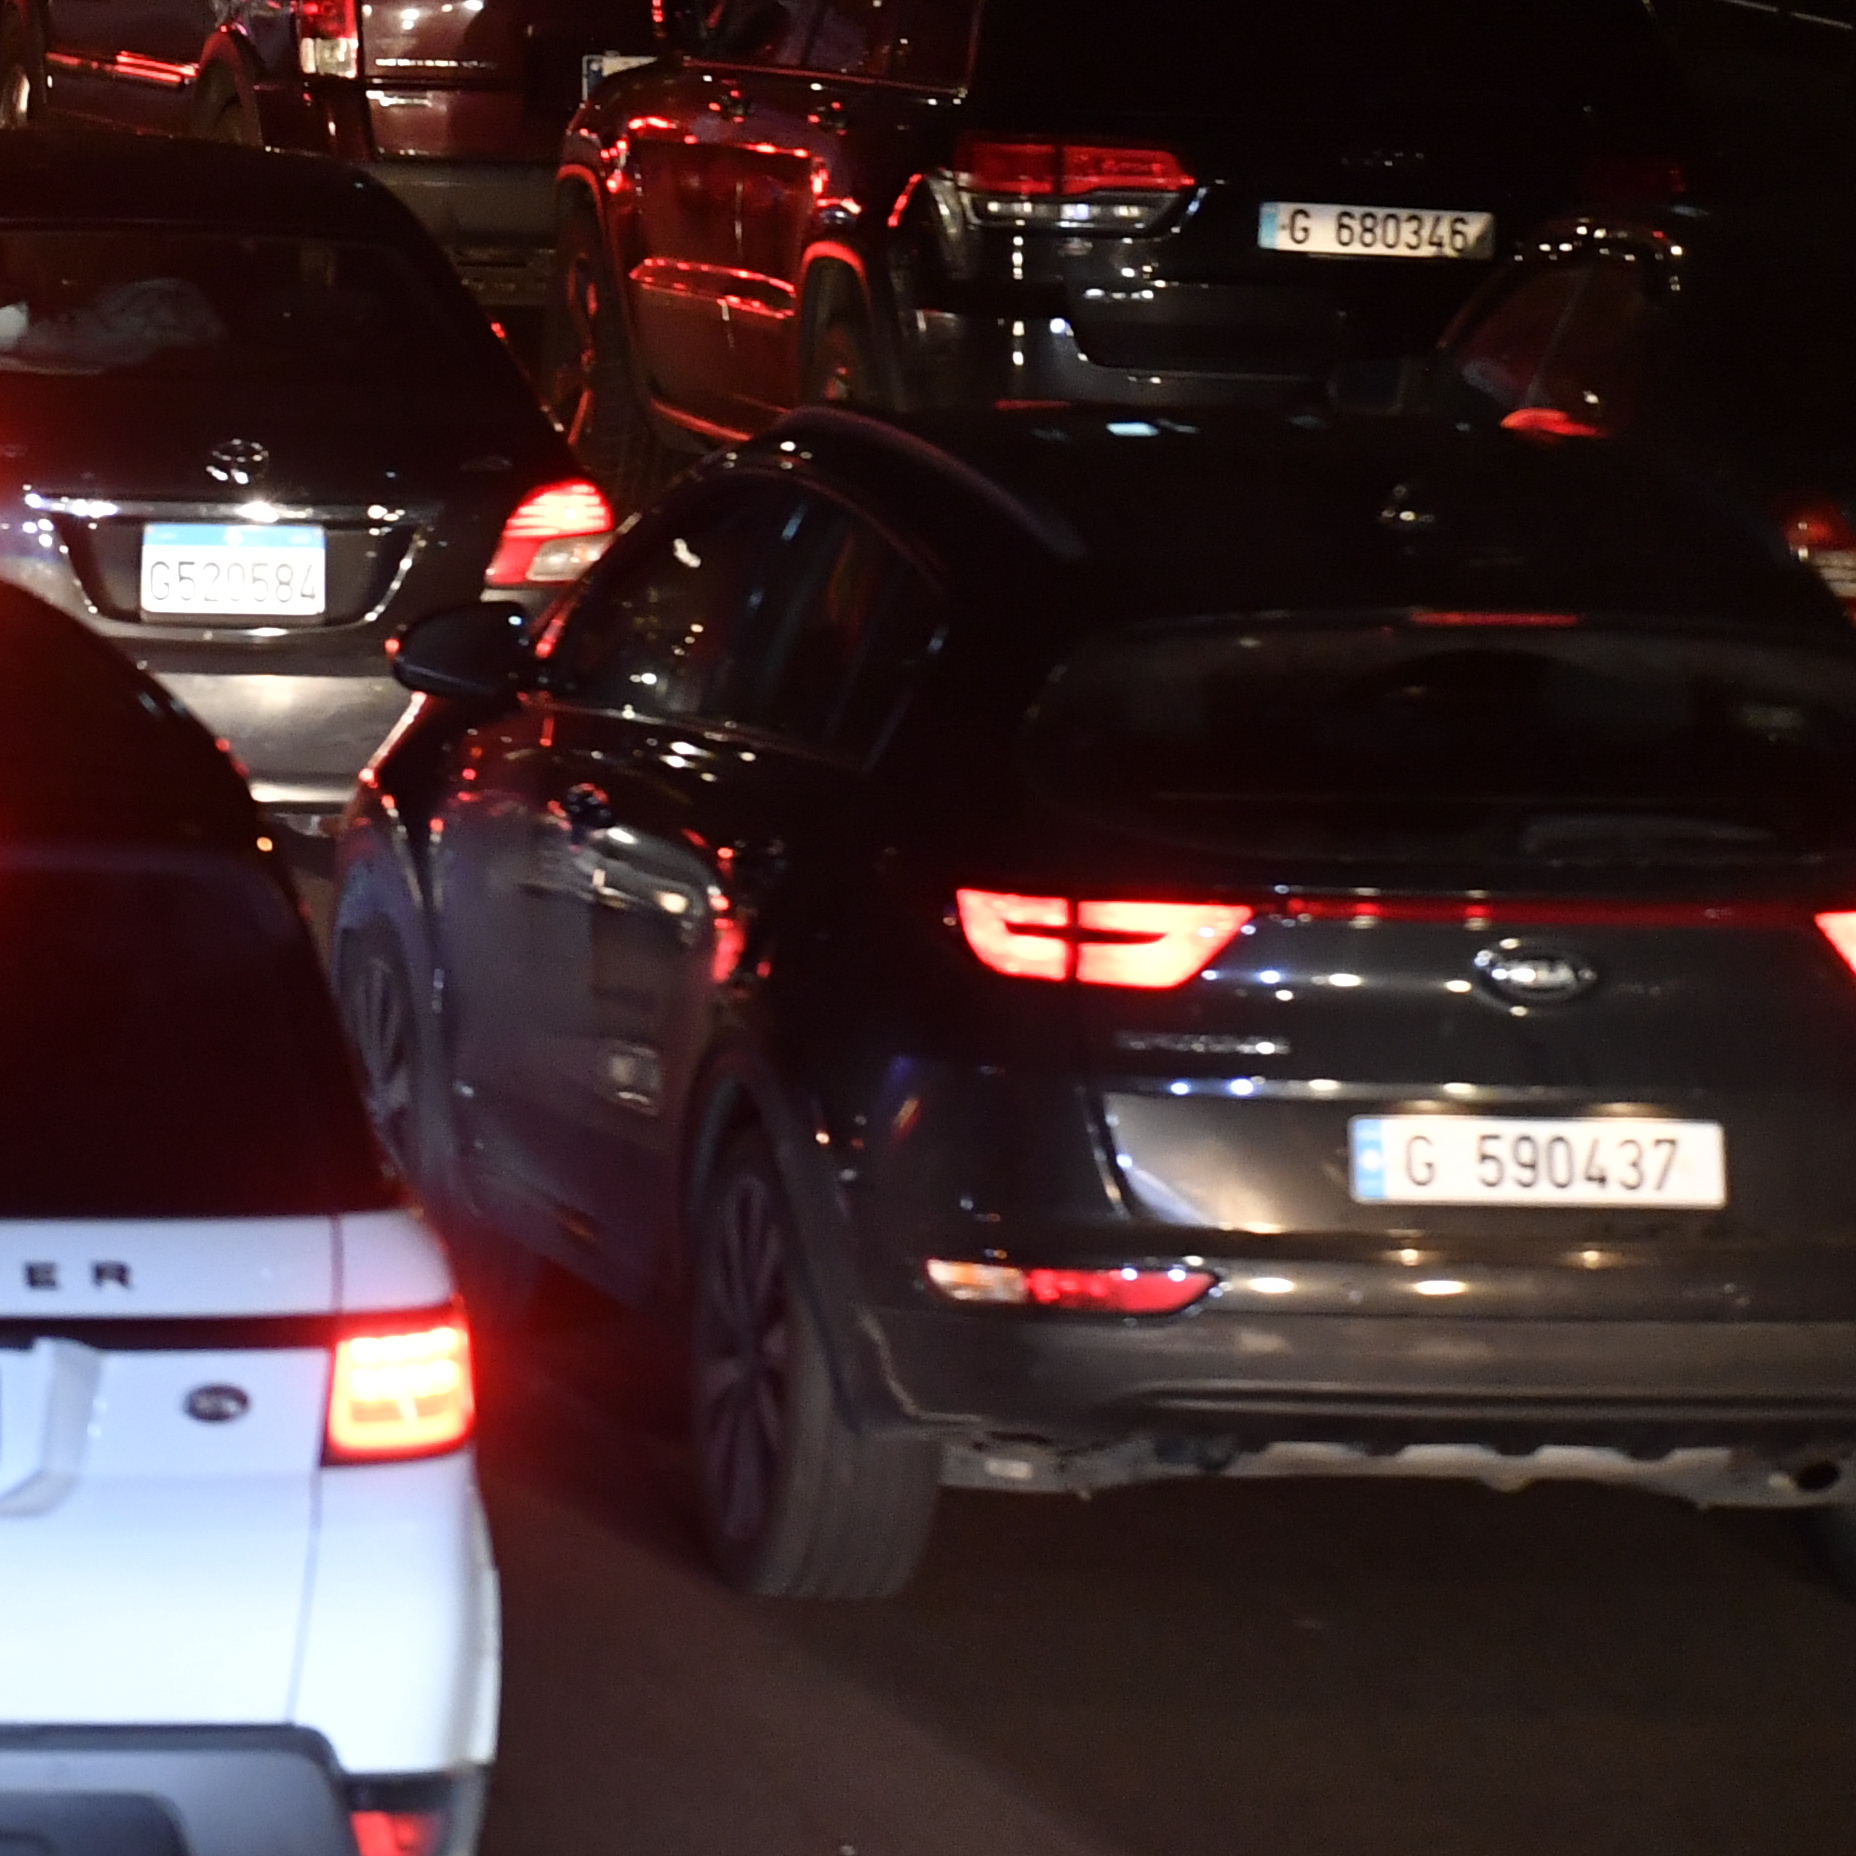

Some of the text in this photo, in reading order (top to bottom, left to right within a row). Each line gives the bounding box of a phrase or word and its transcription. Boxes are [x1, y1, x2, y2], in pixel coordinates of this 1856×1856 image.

[1289, 209, 1469, 253] G 680346
[1404, 1135, 1680, 1191] G 590437
